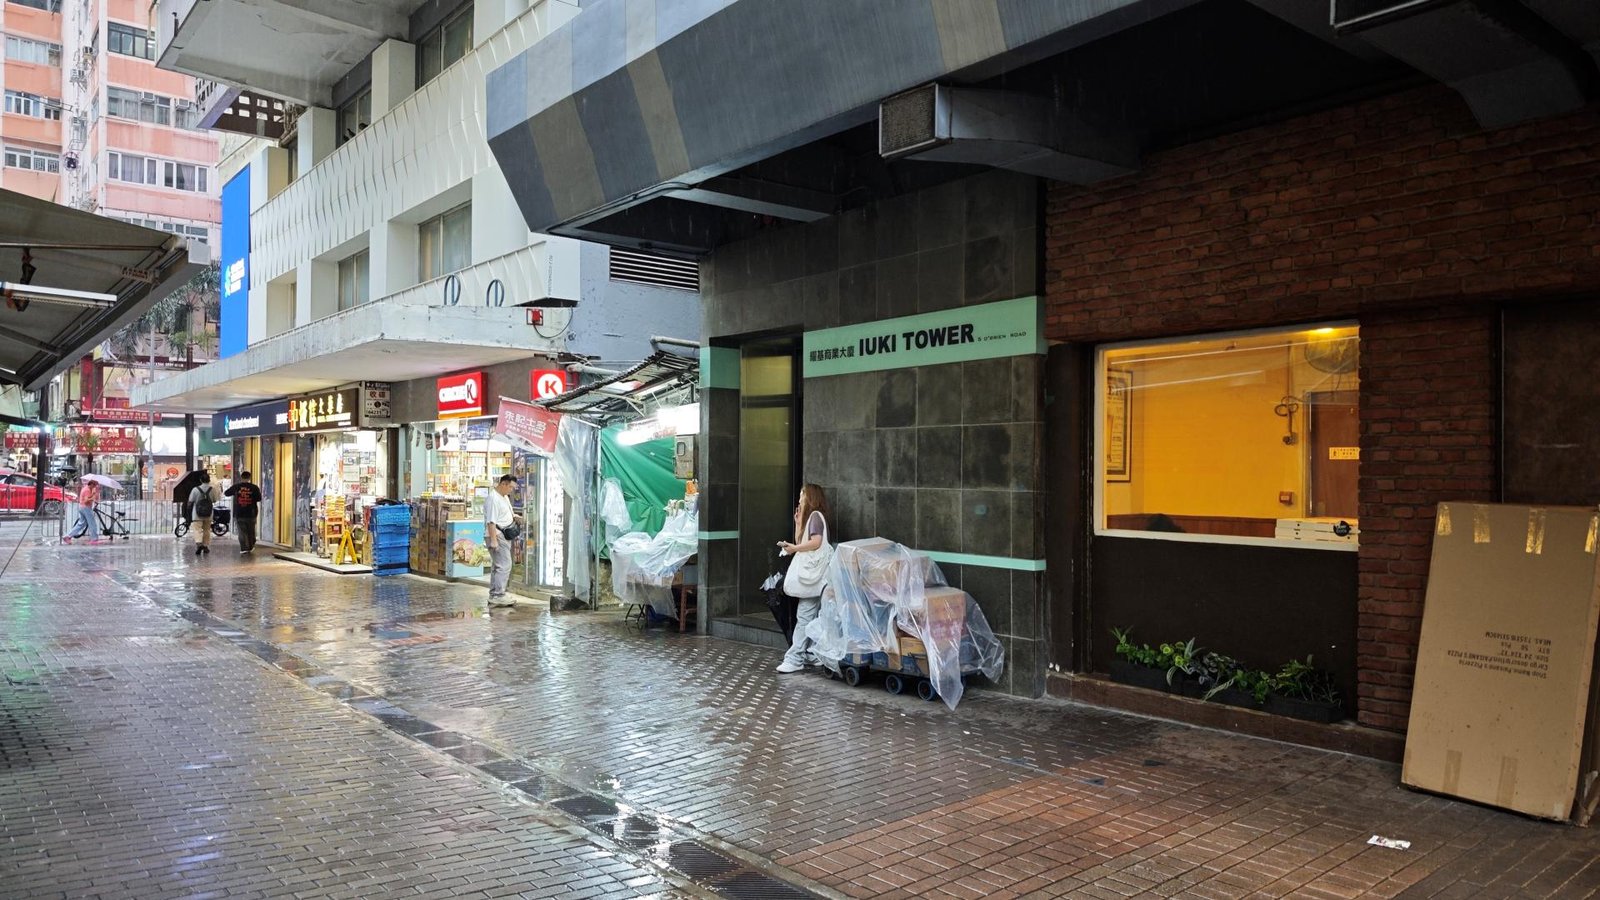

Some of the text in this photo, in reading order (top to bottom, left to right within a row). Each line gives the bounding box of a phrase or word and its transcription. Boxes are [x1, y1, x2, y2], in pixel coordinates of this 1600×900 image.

[859, 333, 897, 357] IUKI
[902, 323, 975, 351] TOWER
[467, 383, 475, 400] K
[545, 380, 558, 395] K
[1458, 659, 1483, 669] Pizzeria
[1530, 663, 1548, 671] Cargo
